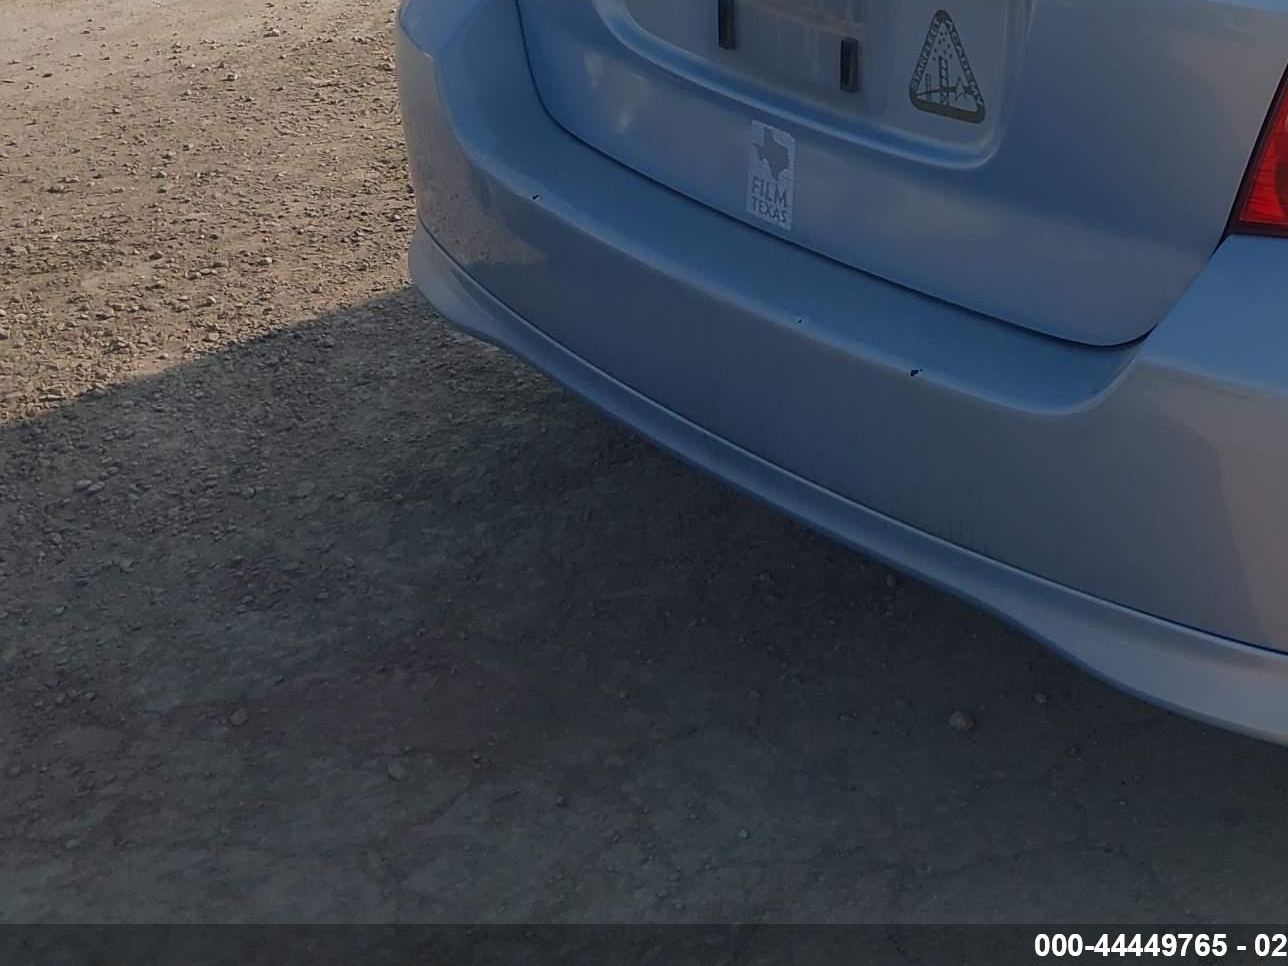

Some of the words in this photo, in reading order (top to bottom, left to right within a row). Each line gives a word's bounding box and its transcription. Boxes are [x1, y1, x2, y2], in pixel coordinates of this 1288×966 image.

[946, 19, 985, 107] ACADEMY
[752, 176, 788, 207] FILM
[752, 197, 787, 222] TEXAS
